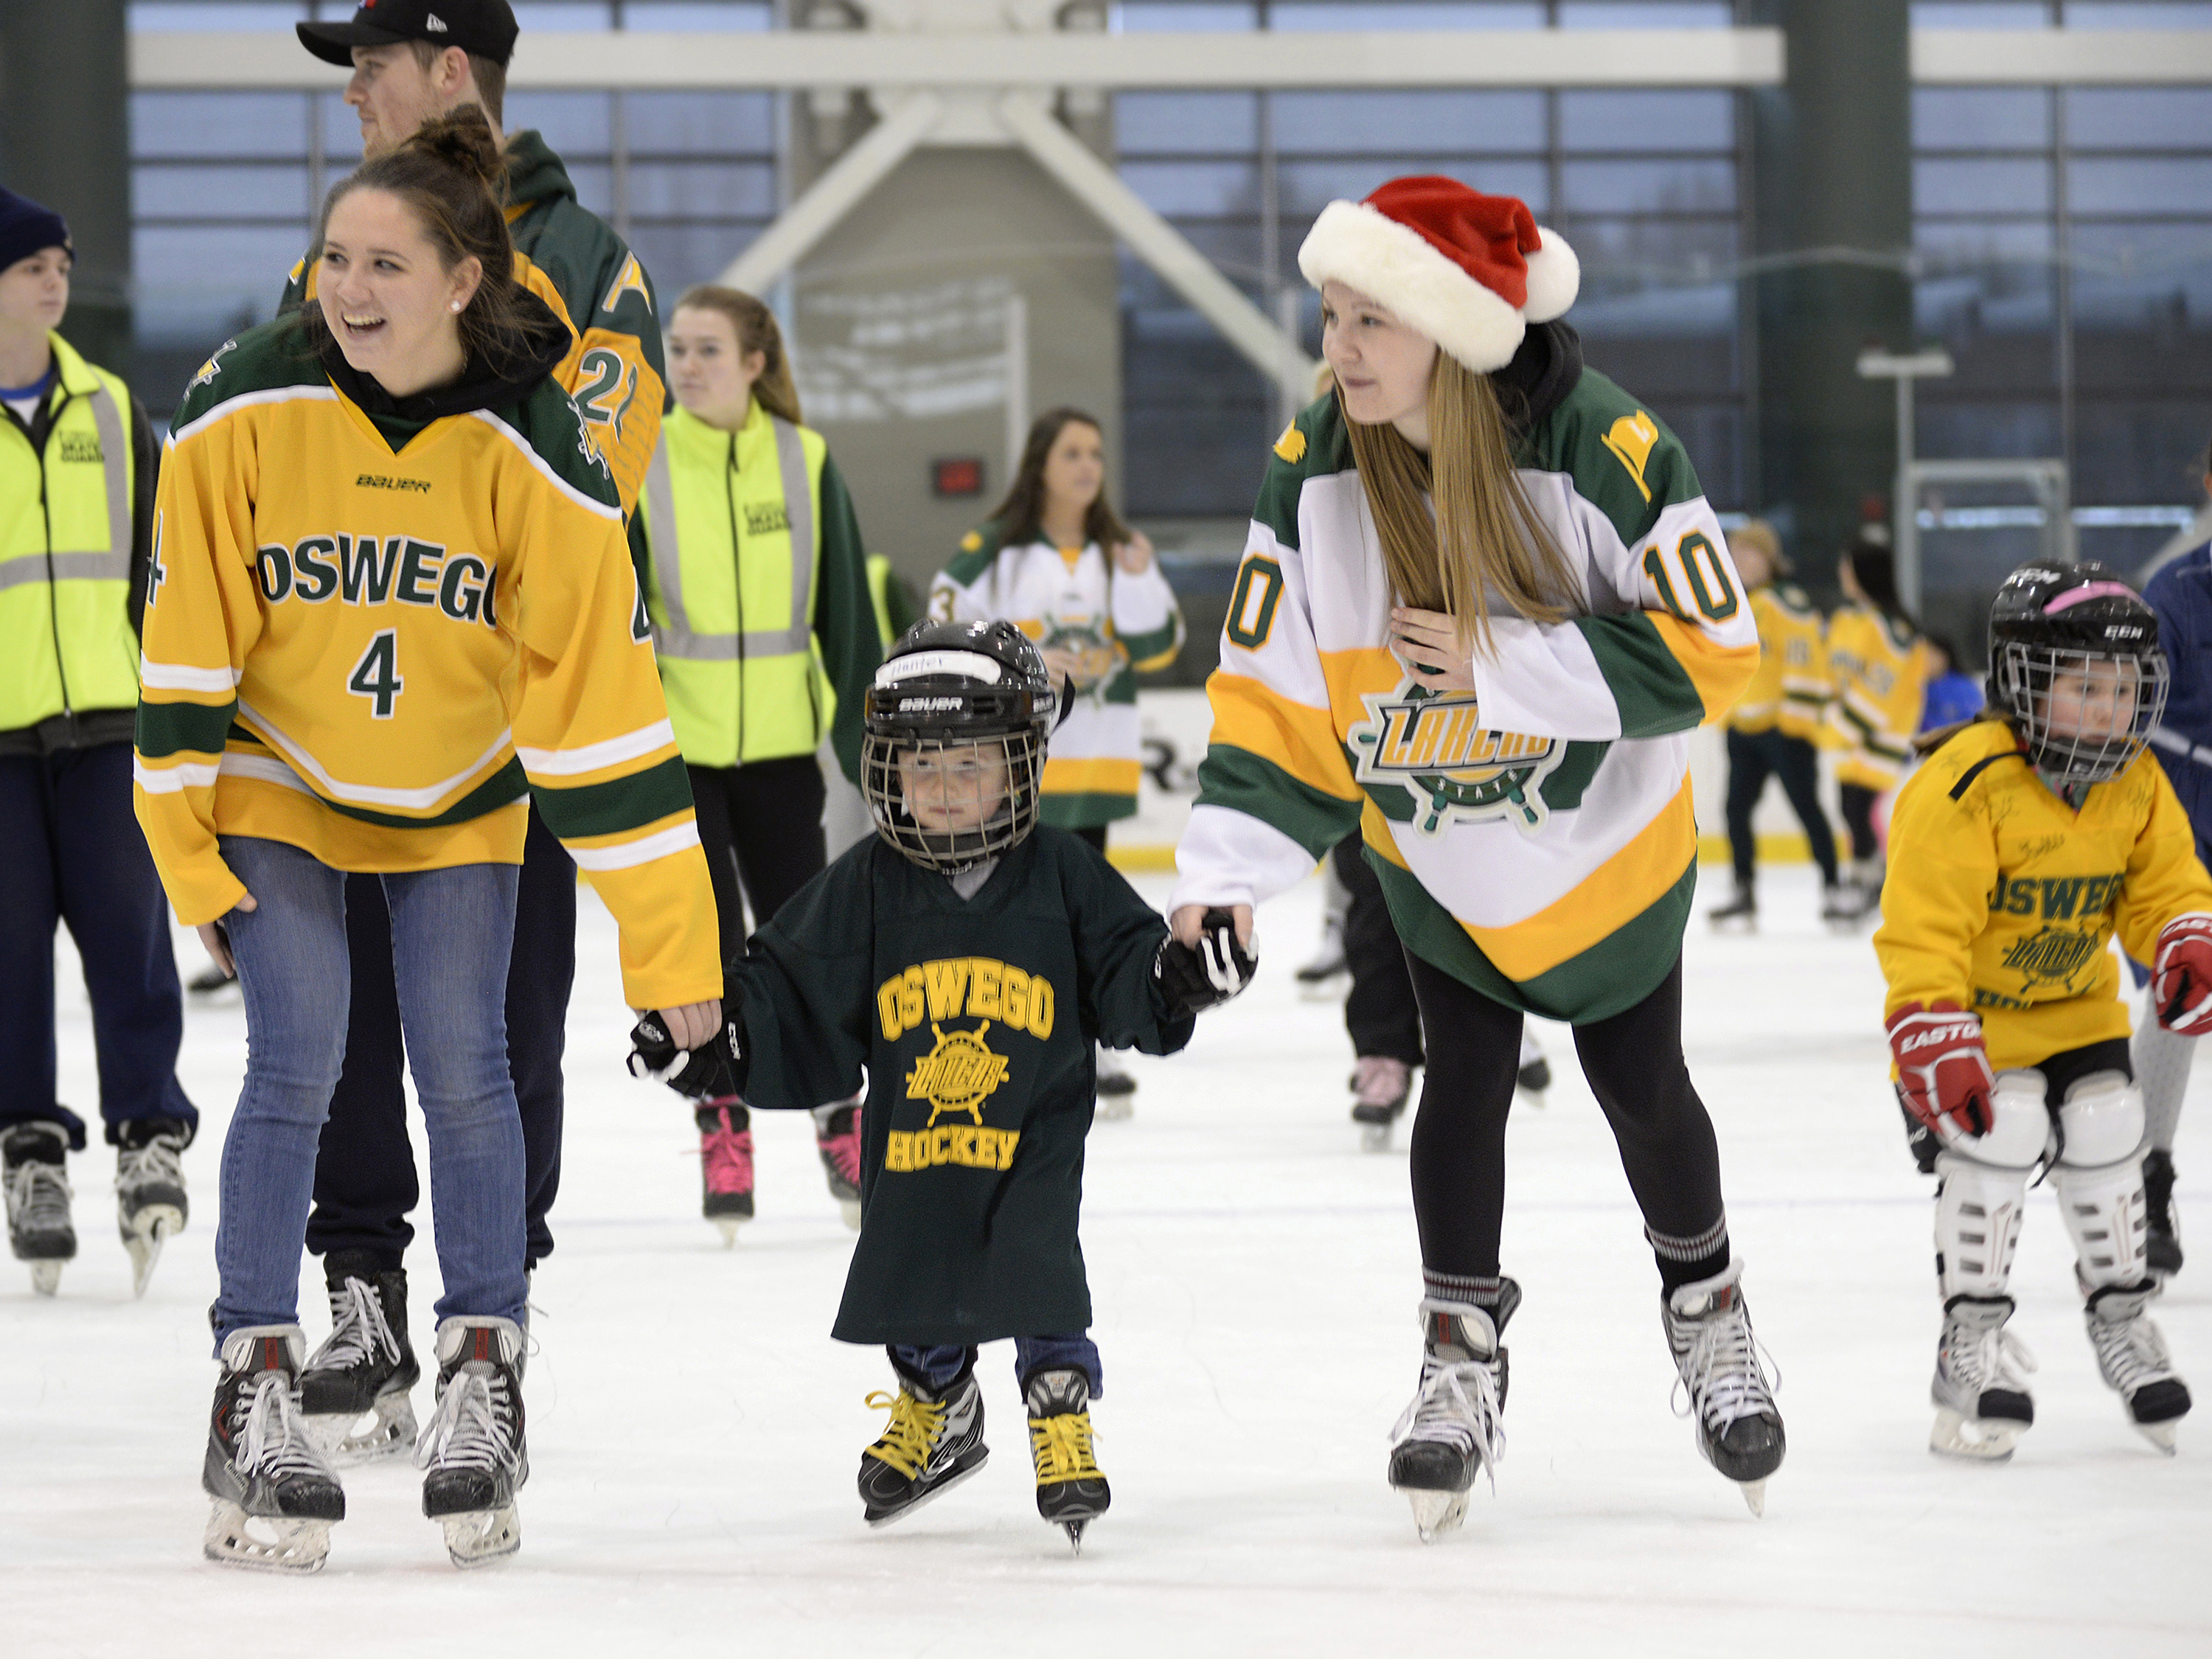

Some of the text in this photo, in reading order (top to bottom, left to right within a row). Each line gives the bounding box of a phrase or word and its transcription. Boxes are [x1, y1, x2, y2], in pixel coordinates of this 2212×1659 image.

[355, 473, 431, 494] BAUER
[1642, 526, 1739, 625] 10
[346, 627, 405, 720] 4
[898, 697, 964, 713] BAUER
[877, 956, 1055, 1042] OSWEGO
[885, 1122, 1021, 1172] HOCKEY
